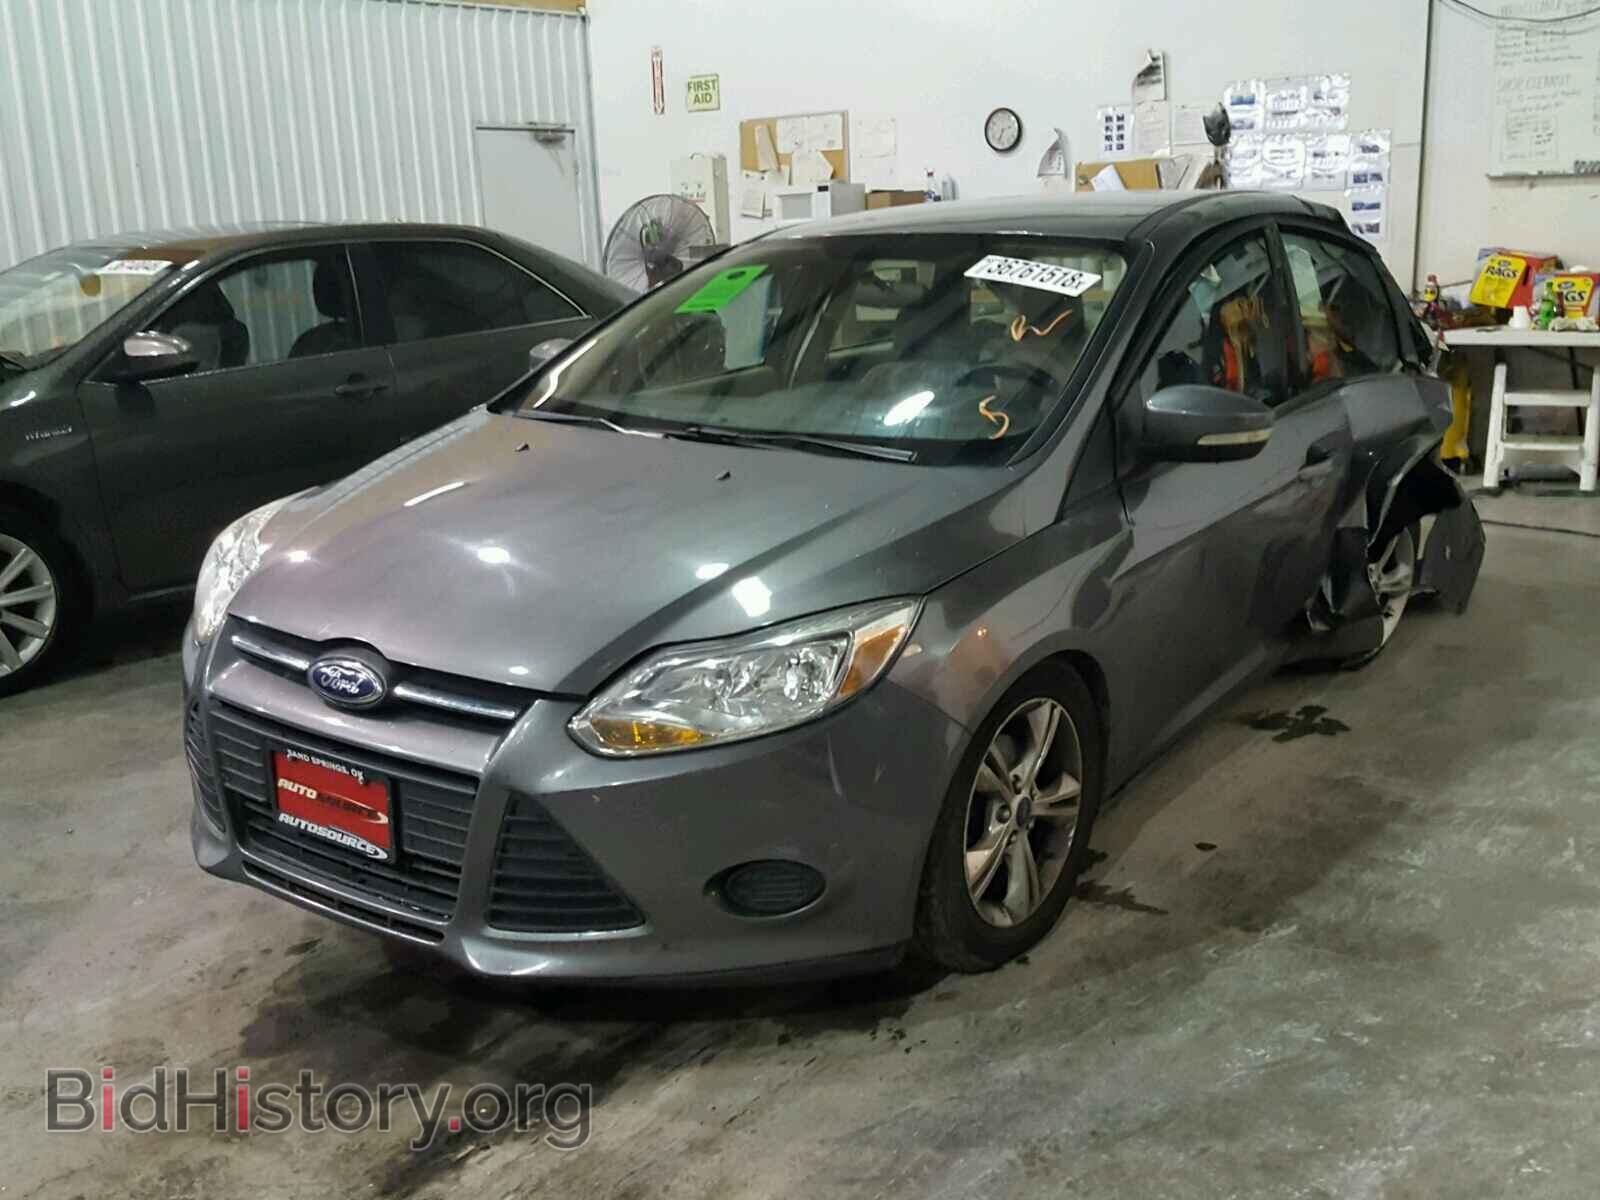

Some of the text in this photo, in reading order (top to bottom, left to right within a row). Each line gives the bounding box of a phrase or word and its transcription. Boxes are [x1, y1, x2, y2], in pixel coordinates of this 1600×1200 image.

[687, 79, 717, 92] FIRST
[693, 92, 713, 105] AID
[1485, 265, 1520, 279] RAGS
[1564, 290, 1587, 302] GS
[320, 665, 363, 695] Ford
[277, 778, 318, 800] AUTO
[278, 813, 378, 855] AUTOSOURCE
